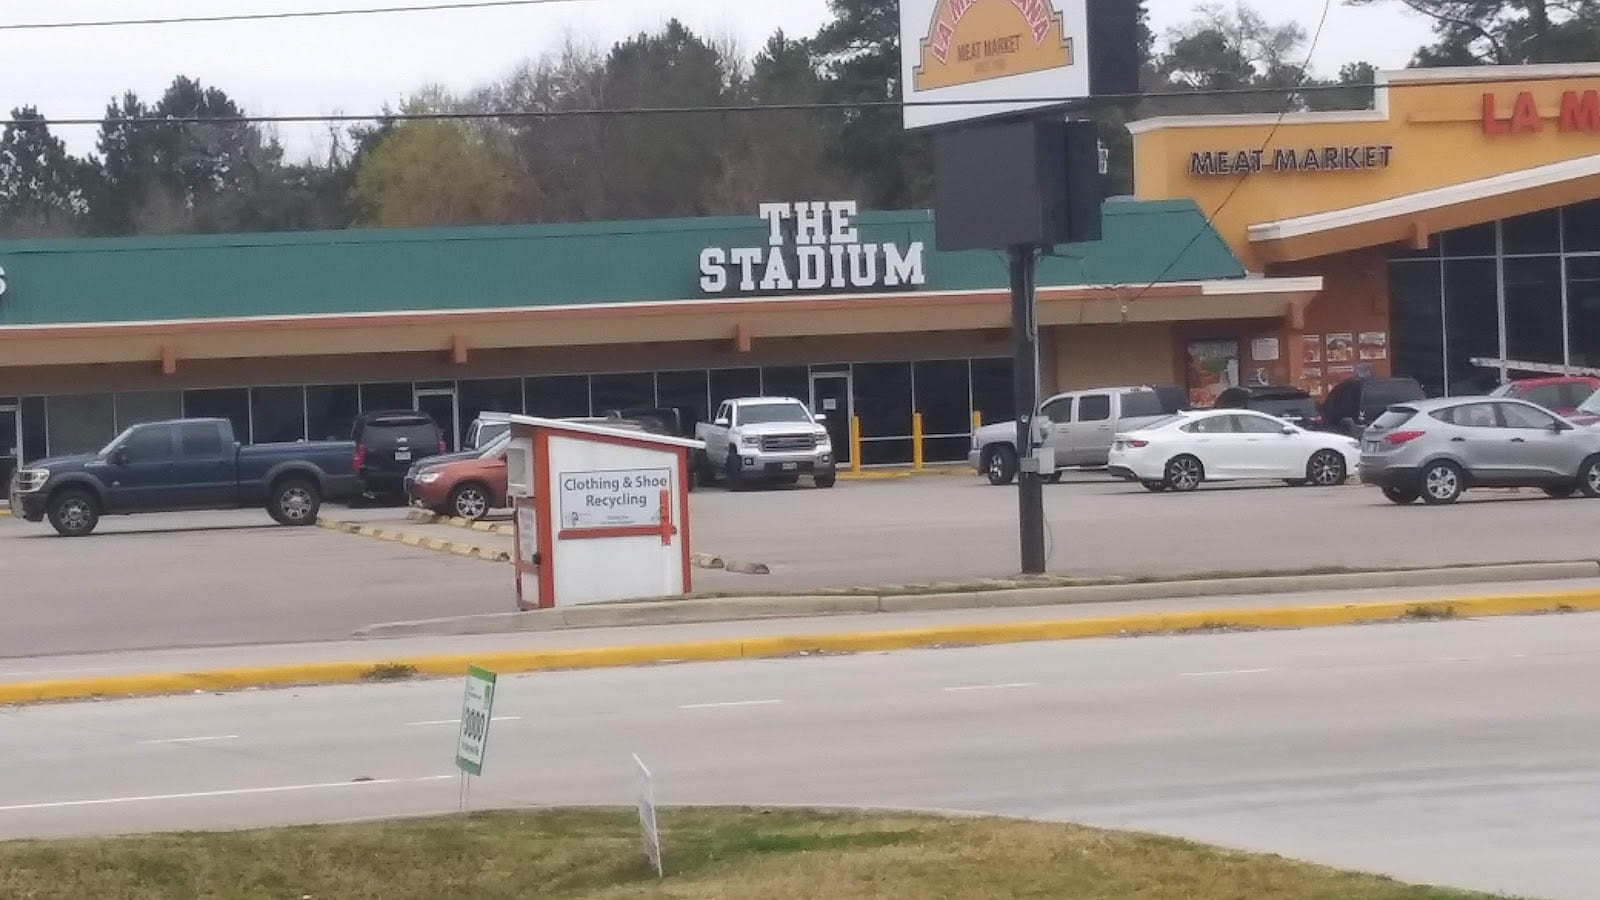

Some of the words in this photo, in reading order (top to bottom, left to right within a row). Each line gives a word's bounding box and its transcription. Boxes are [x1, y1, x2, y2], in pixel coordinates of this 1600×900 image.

[957, 42, 982, 61] MEAT
[984, 35, 1021, 56] MARKET
[1482, 91, 1543, 133] LA
[1188, 149, 1264, 175] MEAT
[1274, 145, 1393, 172] MARKET
[759, 200, 858, 246] THE
[699, 242, 925, 292] STADIUM
[564, 477, 620, 492] Clothing
[622, 476, 632, 488] &
[635, 474, 667, 488] Shoe
[585, 493, 647, 509] Recycling
